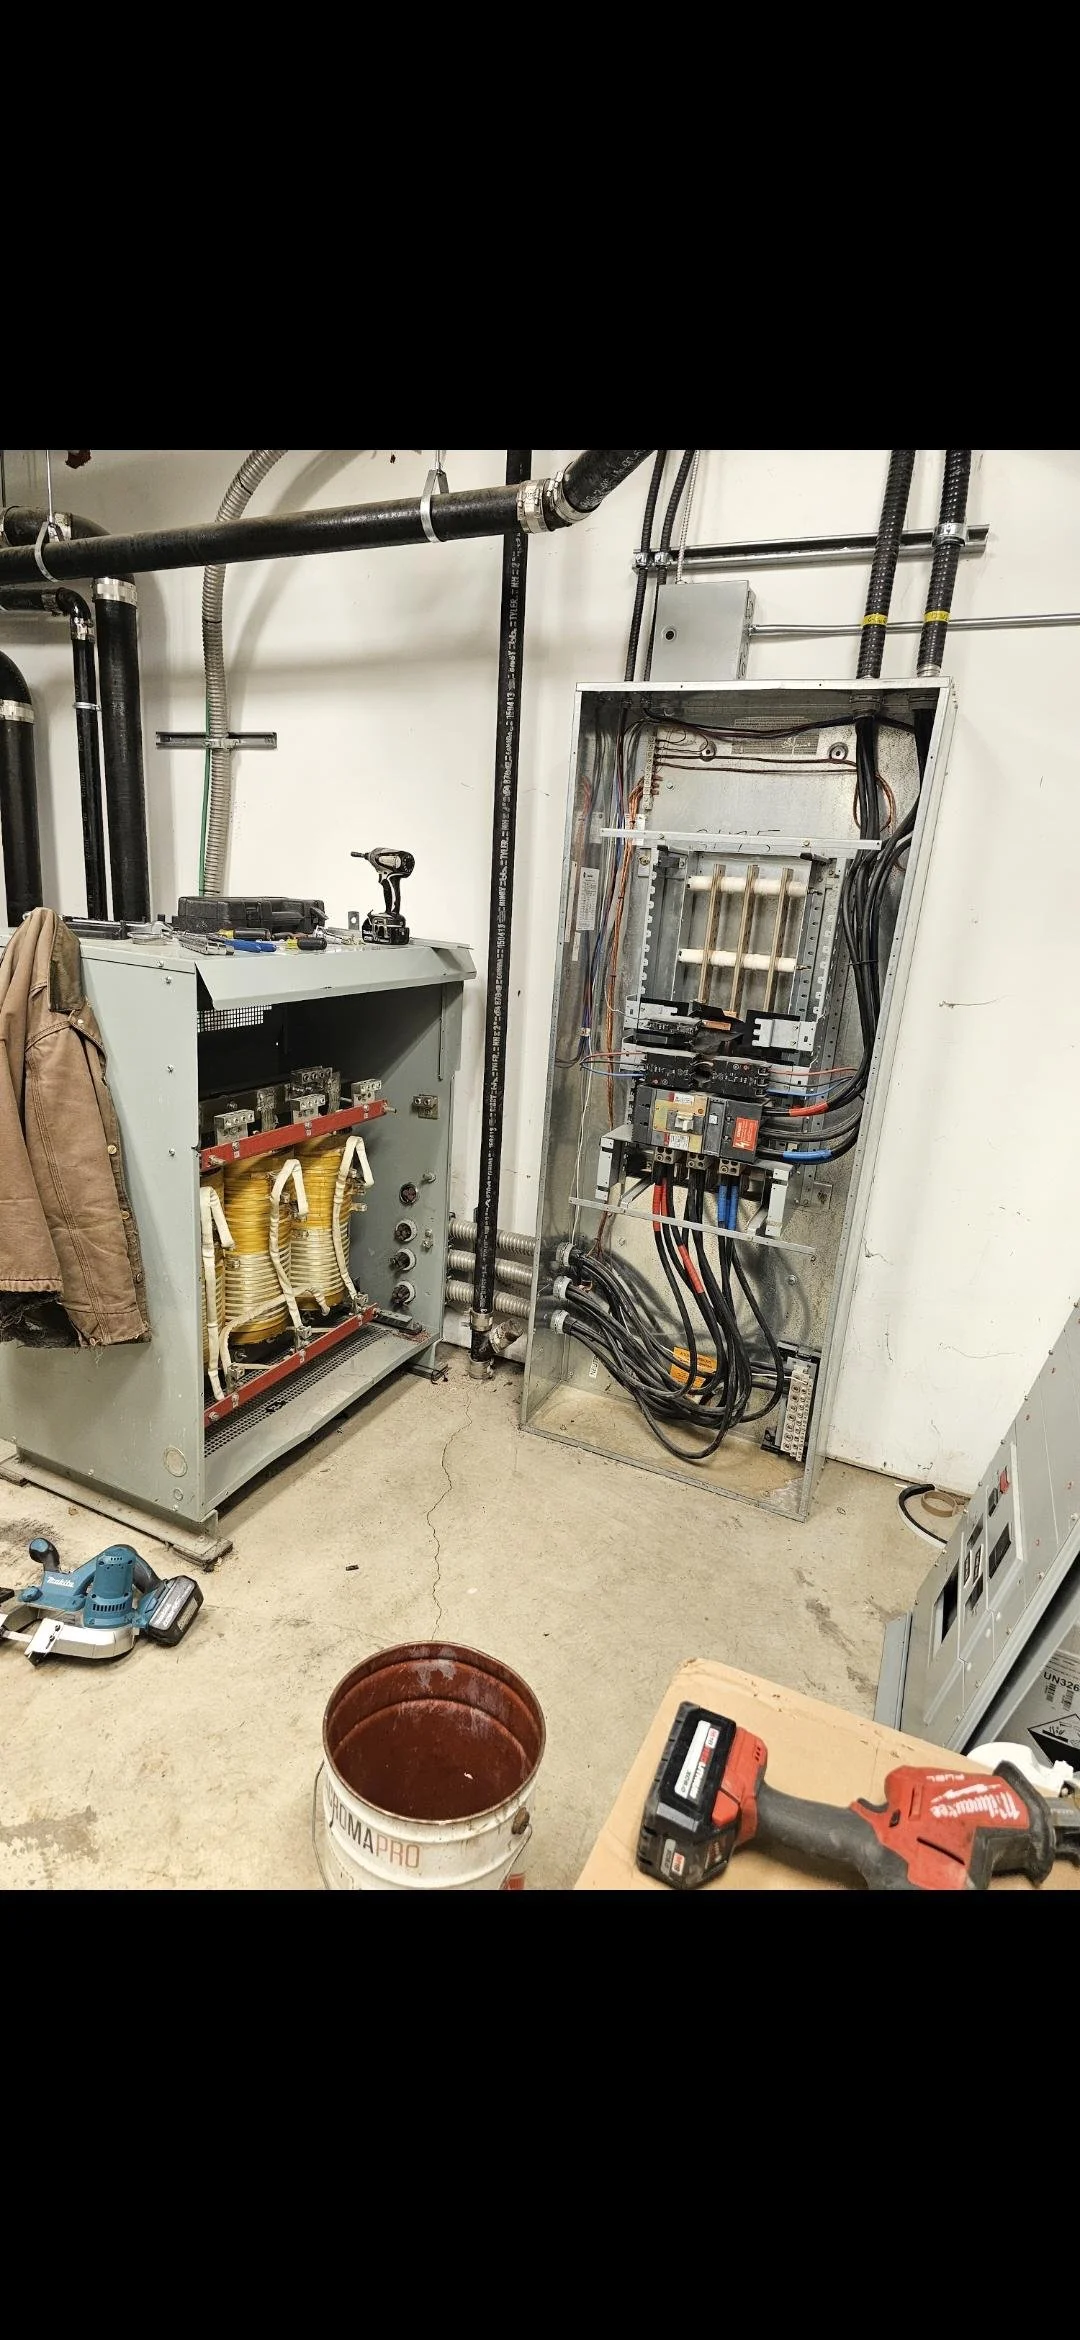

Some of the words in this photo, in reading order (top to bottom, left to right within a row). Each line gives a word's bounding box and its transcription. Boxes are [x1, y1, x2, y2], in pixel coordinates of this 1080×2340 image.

[47, 1576, 74, 1588] Makita
[926, 1773, 965, 1783] FUEL
[930, 1791, 1020, 1821] Milwaukee
